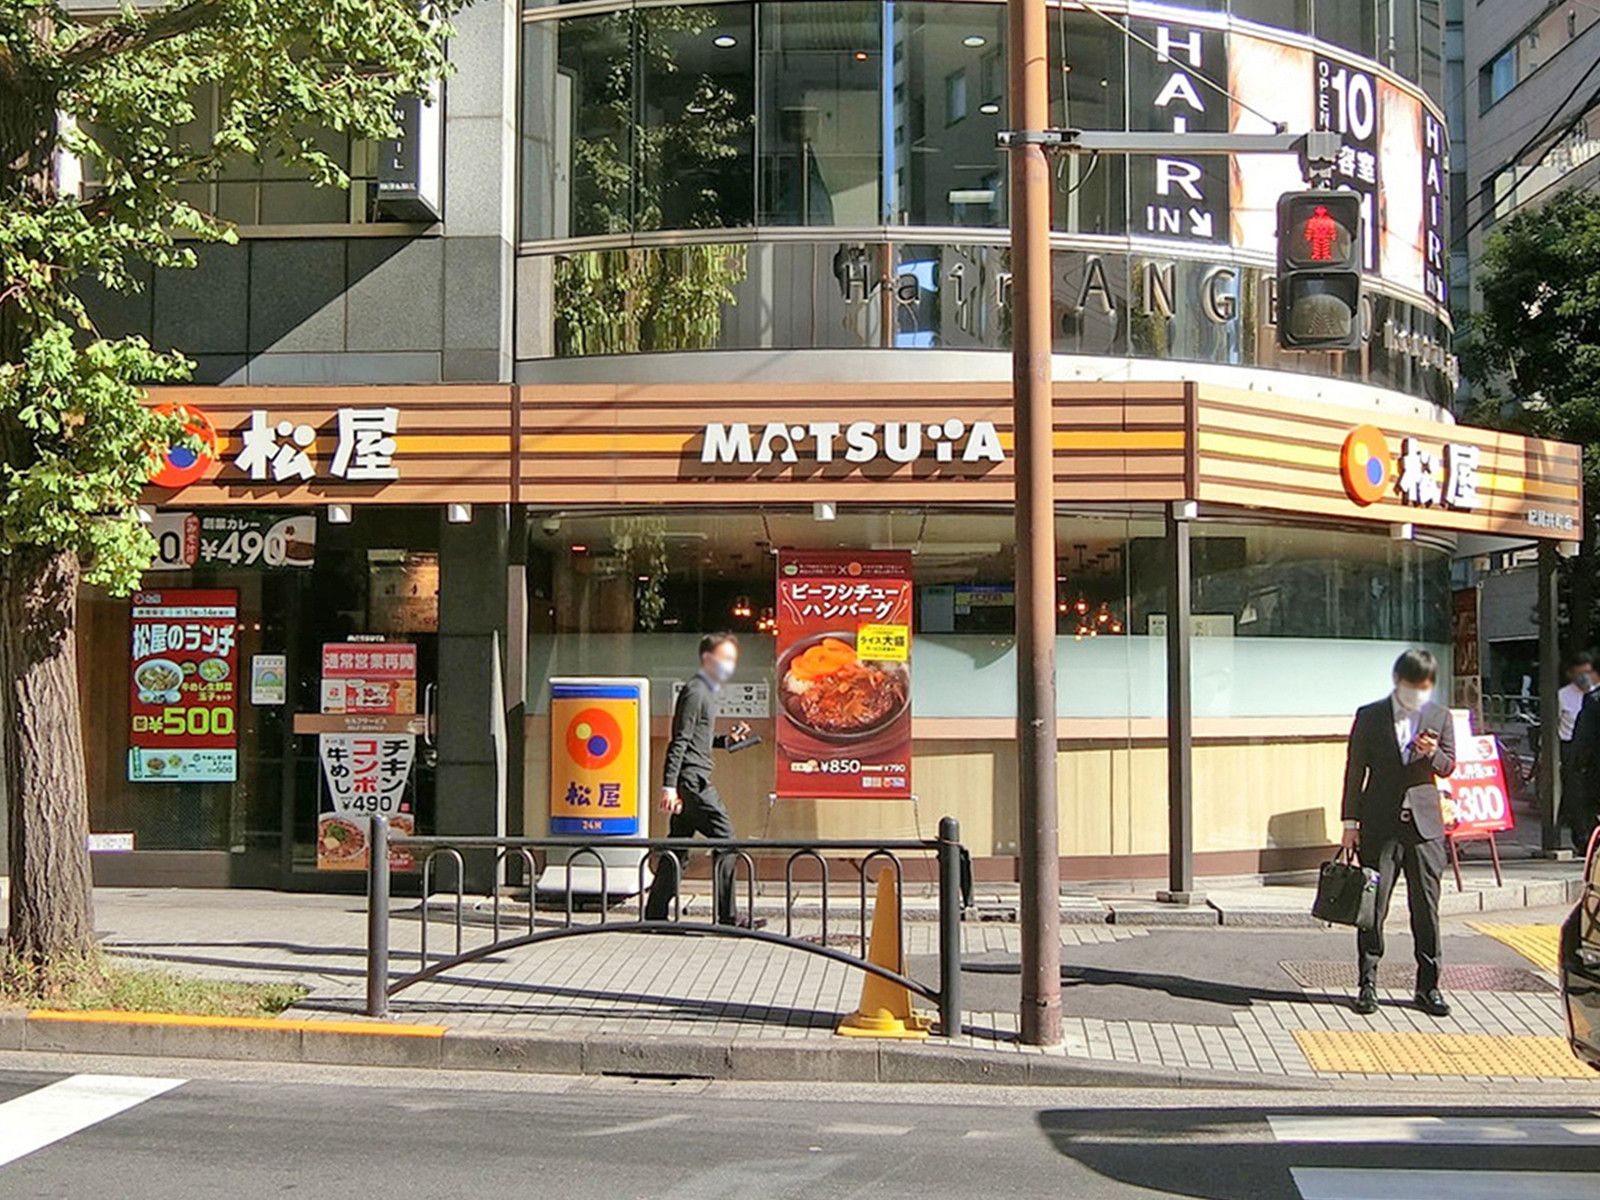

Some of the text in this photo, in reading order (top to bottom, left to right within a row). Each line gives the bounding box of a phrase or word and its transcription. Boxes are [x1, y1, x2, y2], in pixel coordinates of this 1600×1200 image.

[1331, 68, 1374, 141] 10
[394, 109, 406, 169] NAIL
[1331, 145, 1376, 184] 容室
[1426, 116, 1443, 270] HAIR
[1146, 205, 1180, 233] IN
[844, 262, 1013, 306] Hair
[234, 407, 399, 481] 松屋
[700, 418, 1005, 463] MATSUYA
[1399, 437, 1481, 509] 松屋
[201, 531, 286, 566] ¥490
[792, 583, 899, 601] ビーフシチュー
[802, 601, 894, 619] ハンバーグ
[133, 624, 235, 660] 松屋のランチ
[149, 707, 234, 735] ¥500
[327, 747, 350, 794] 牛めし
[352, 740, 378, 793] コンボ
[381, 740, 409, 793] チキン
[821, 760, 861, 773] ¥850
[342, 796, 392, 812] ¥490
[565, 782, 620, 808] 松屋
